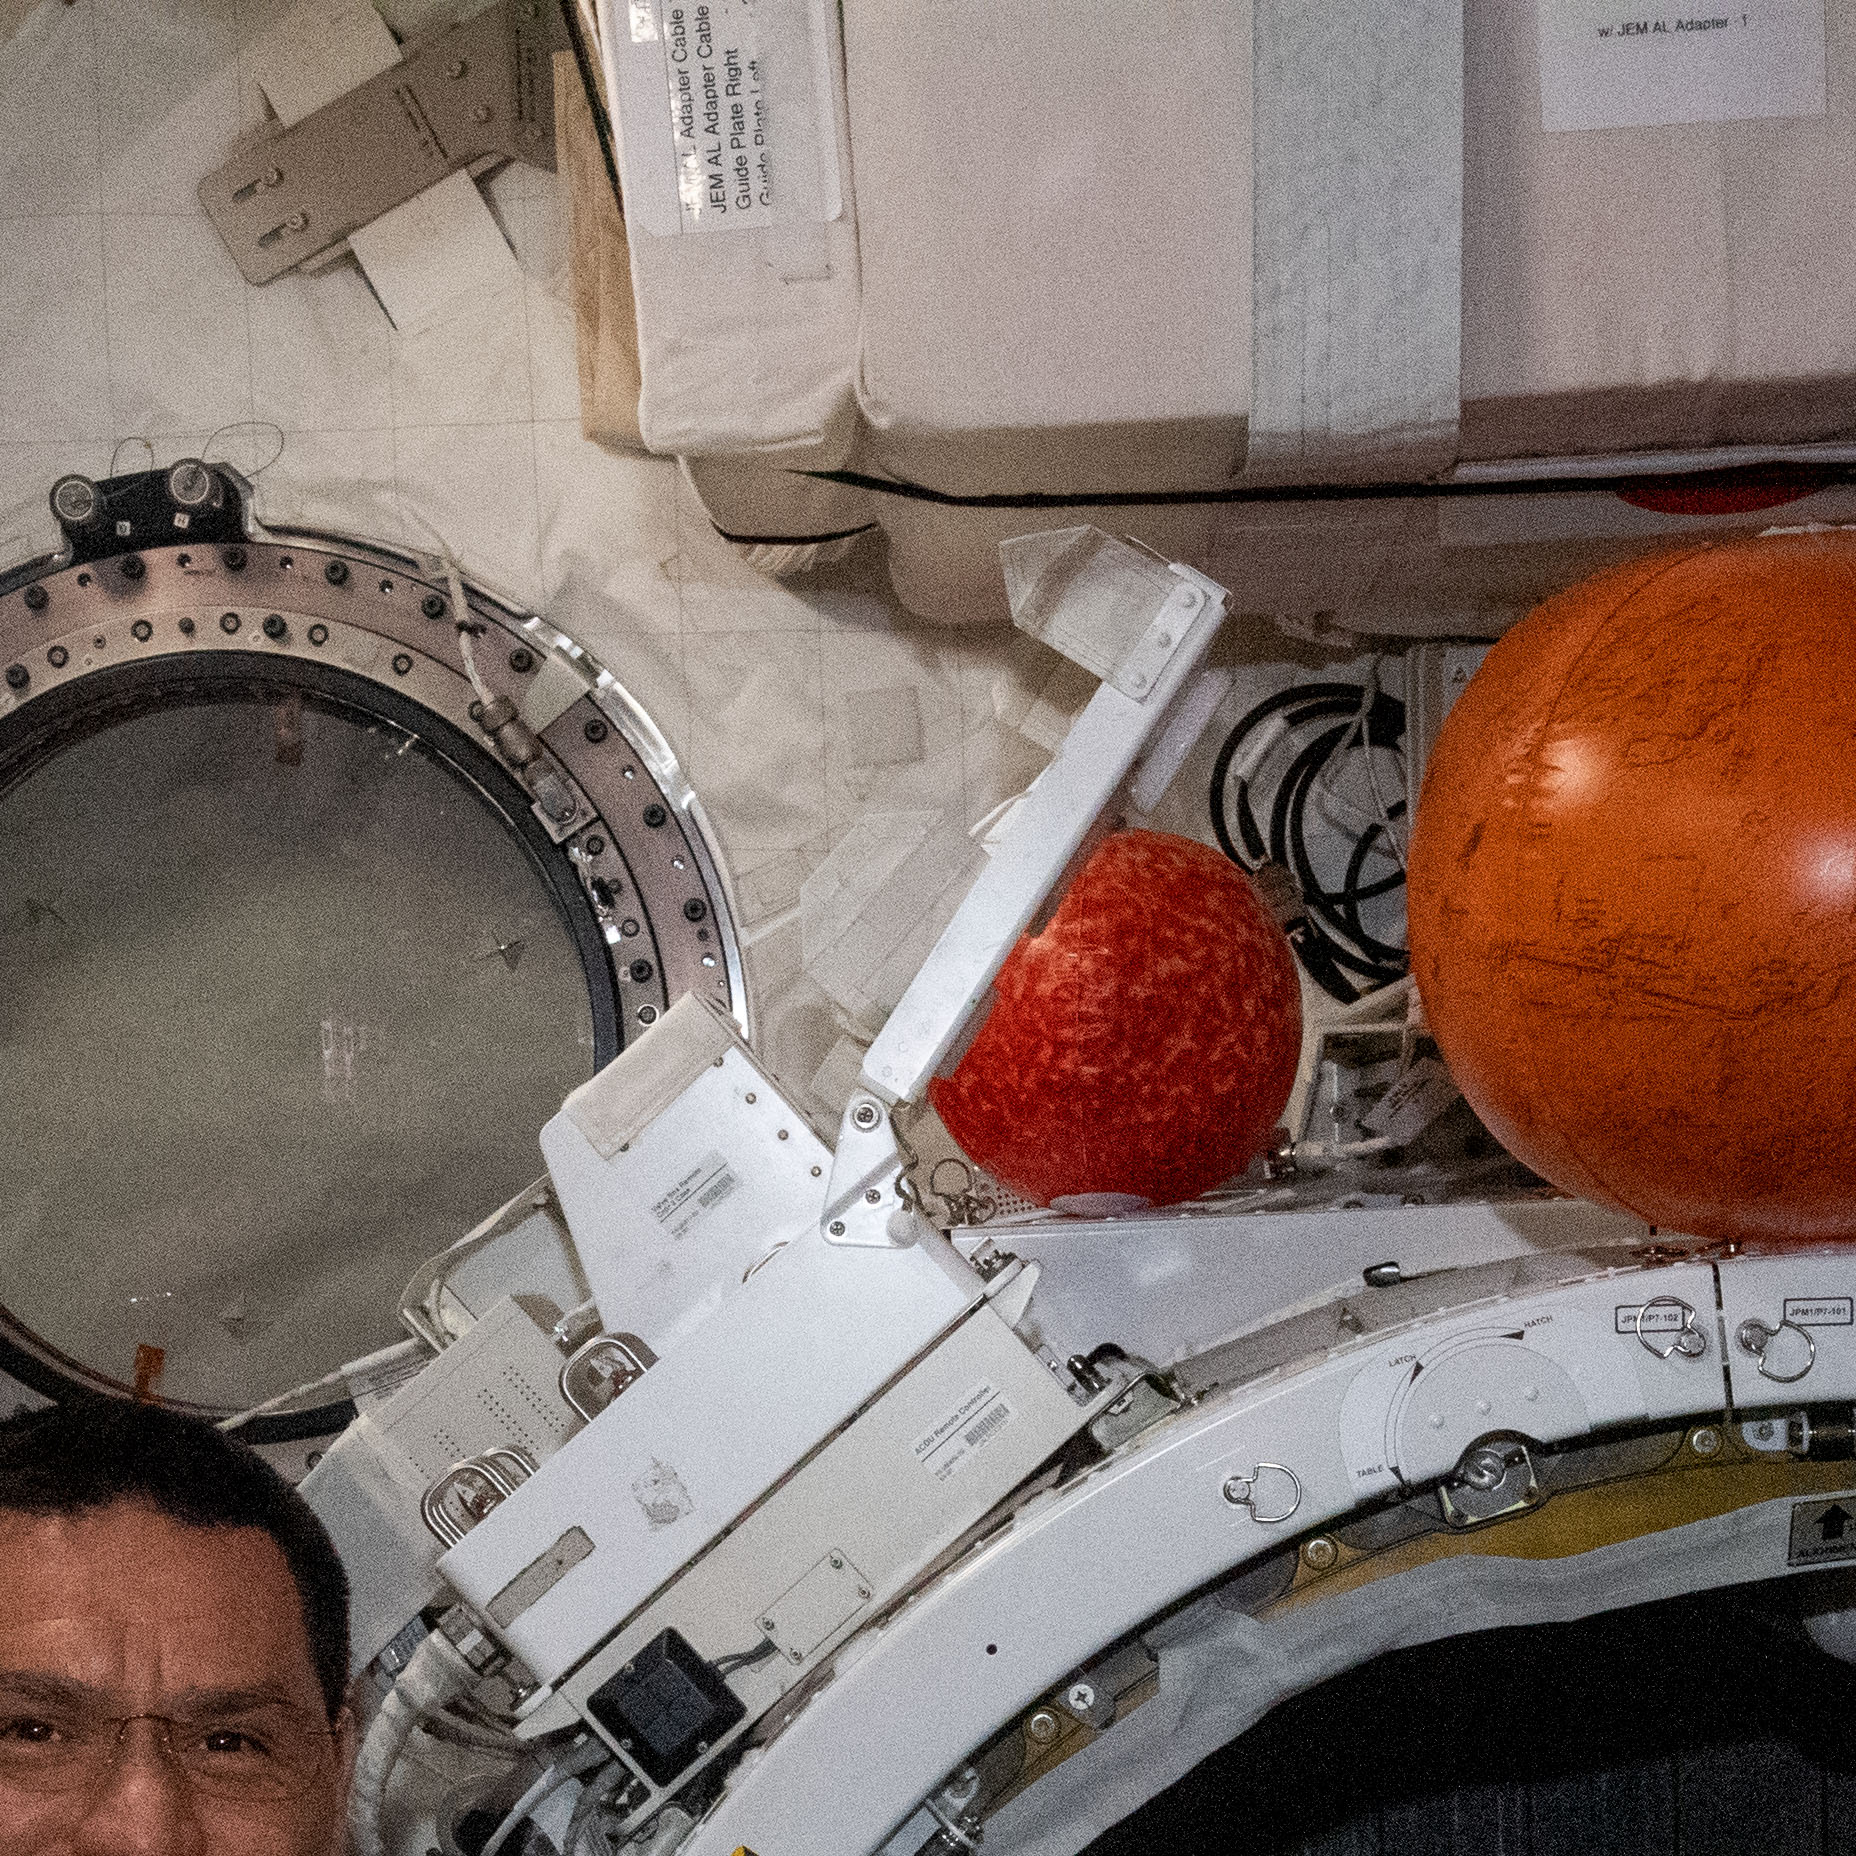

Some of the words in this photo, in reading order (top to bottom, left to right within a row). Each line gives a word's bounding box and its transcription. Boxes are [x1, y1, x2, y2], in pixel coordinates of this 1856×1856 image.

[670, 9, 688, 63] Cable
[695, 5, 712, 58] Cable
[1617, 21, 1648, 36] JEM
[1653, 21, 1670, 34] AL
[1676, 17, 1728, 32] Adapter
[724, 48, 743, 96] Right
[676, 69, 695, 139] Adapter
[701, 65, 720, 135] Adapter
[729, 102, 746, 149] Plate
[706, 142, 722, 167] AL
[708, 173, 727, 214] JEM
[732, 155, 752, 210] Guide
[1523, 1314, 1554, 1329] HATCH
[1388, 1354, 1417, 1368] LATCH
[933, 1413, 961, 1438] Remote
[957, 1384, 993, 1416] Controller
[1357, 1464, 1385, 1478] TABLE
